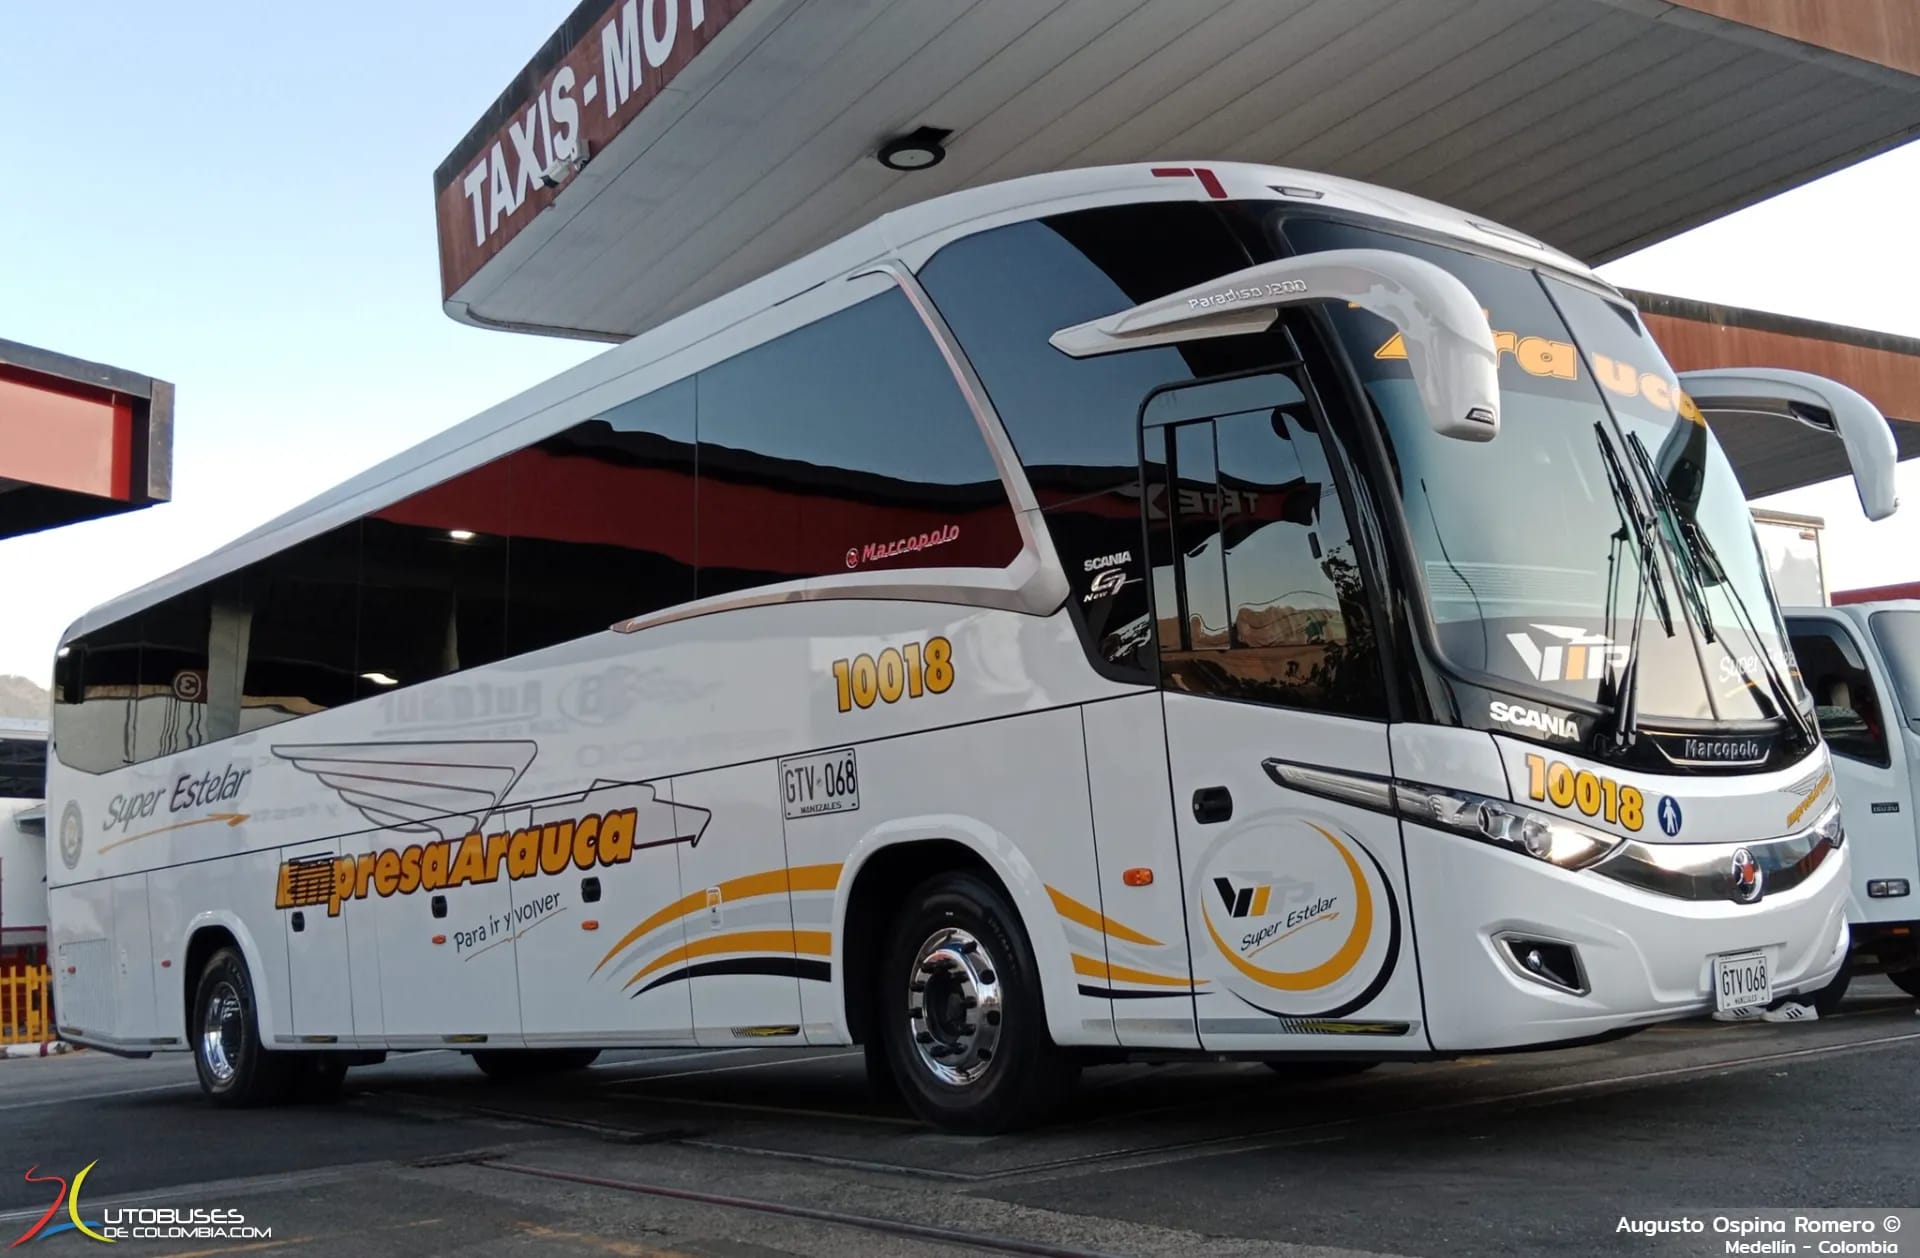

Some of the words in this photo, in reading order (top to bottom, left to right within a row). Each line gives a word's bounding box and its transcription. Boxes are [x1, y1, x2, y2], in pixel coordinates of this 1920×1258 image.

[1188, 288, 1263, 310] Paradiso
[1266, 279, 1308, 296] 1200
[861, 524, 960, 562] Marcopolo
[1083, 551, 1132, 572] SCANIA
[832, 636, 955, 713] 10018
[1489, 701, 1581, 743] SCANIA
[1684, 738, 1760, 760] Marcopolo
[102, 788, 167, 833] Super
[169, 763, 252, 813] Estelar
[785, 764, 814, 804] GTV
[825, 758, 857, 798] 068
[1525, 753, 1645, 832] 10018
[453, 925, 487, 953] Para
[489, 914, 500, 936] ir
[503, 912, 511, 931] y
[514, 892, 561, 924] volver
[1240, 920, 1283, 952] Super
[1286, 896, 1338, 928] Estelar
[1722, 967, 1743, 997] GTV
[1745, 965, 1767, 993] 068
